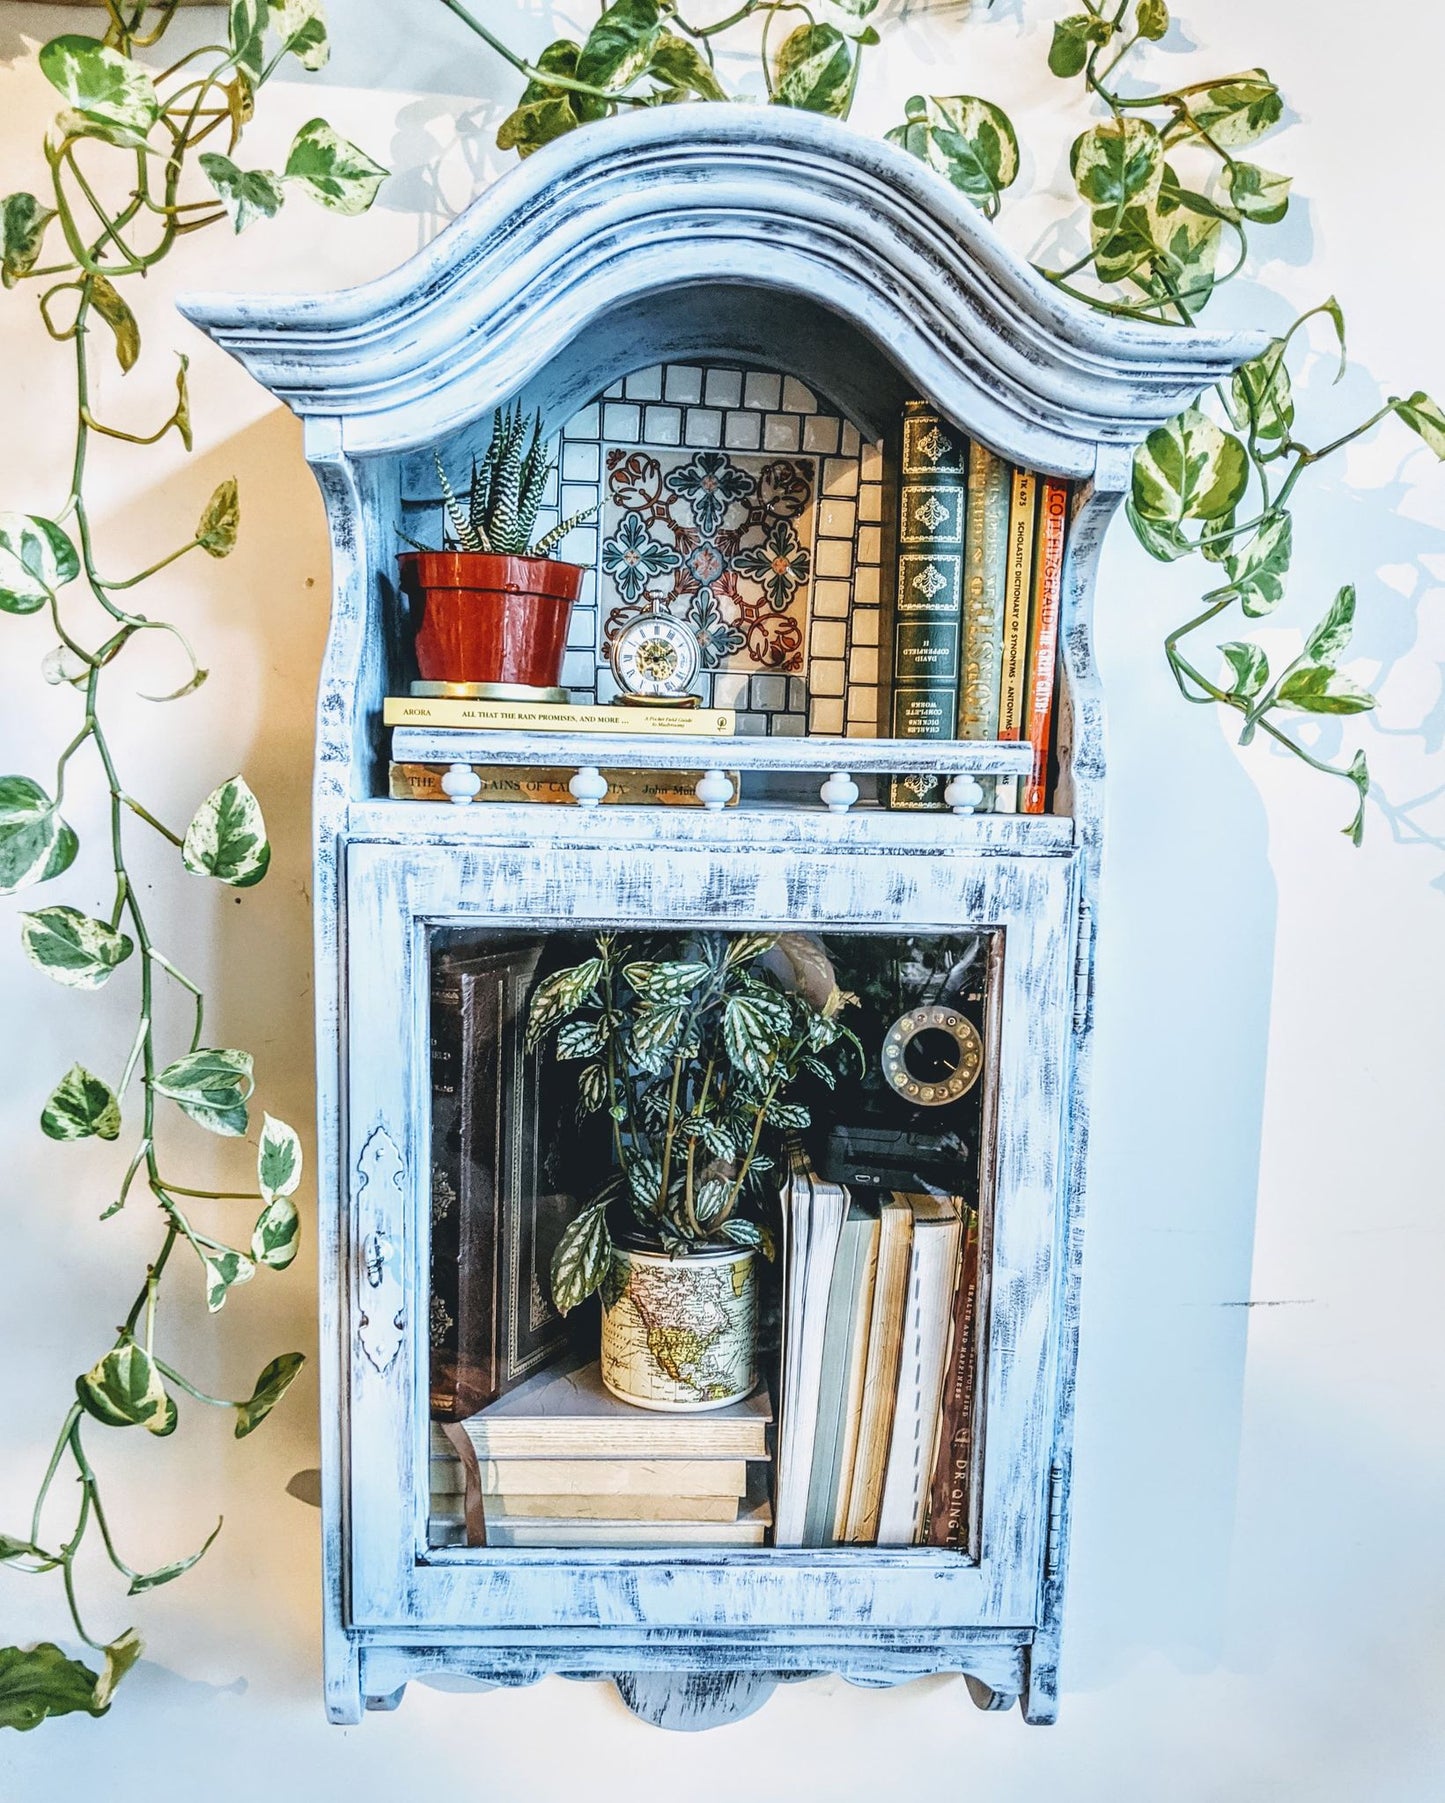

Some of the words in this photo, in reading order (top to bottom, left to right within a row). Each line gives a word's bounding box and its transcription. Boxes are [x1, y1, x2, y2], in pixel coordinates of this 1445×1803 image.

[1019, 478, 1028, 490] TK
[1018, 491, 1027, 507] 675
[1049, 484, 1066, 532] SCOTT
[1015, 521, 1025, 568] SCHOLASTIC
[1041, 538, 1060, 625] FITZGERALD
[1012, 570, 1023, 619] DICTIONARY
[1011, 620, 1019, 632] OF
[1039, 629, 1055, 646] THE
[903, 648, 950, 656] COPPERFIELD
[914, 655, 938, 663] DAVID
[1008, 634, 1018, 678] SYNONYMS
[1037, 649, 1054, 677] GREAT
[910, 701, 938, 709] WORKS
[1035, 680, 1052, 714] GATSBY
[403, 708, 432, 716] ARORA
[477, 711, 498, 719] THAT
[499, 712, 516, 720] THE
[517, 713, 537, 721] RAIN
[538, 713, 578, 723] PROMISES,
[579, 715, 596, 723] AND
[597, 716, 620, 724] MORE
[905, 708, 943, 716] COMPLETE
[1005, 686, 1015, 730] ANTONYMS
[907, 726, 940, 734] CHARLES
[407, 776, 436, 788] THE
[526, 781, 543, 792] OF
[642, 784, 668, 796] John
[964, 1284, 975, 1321] HEALTH
[961, 1324, 970, 1344] AND
[955, 1346, 968, 1400] HAPPINESS
[962, 1394, 971, 1417] FIND
[954, 1459, 968, 1484] DR.
[948, 1488, 963, 1529] QING
